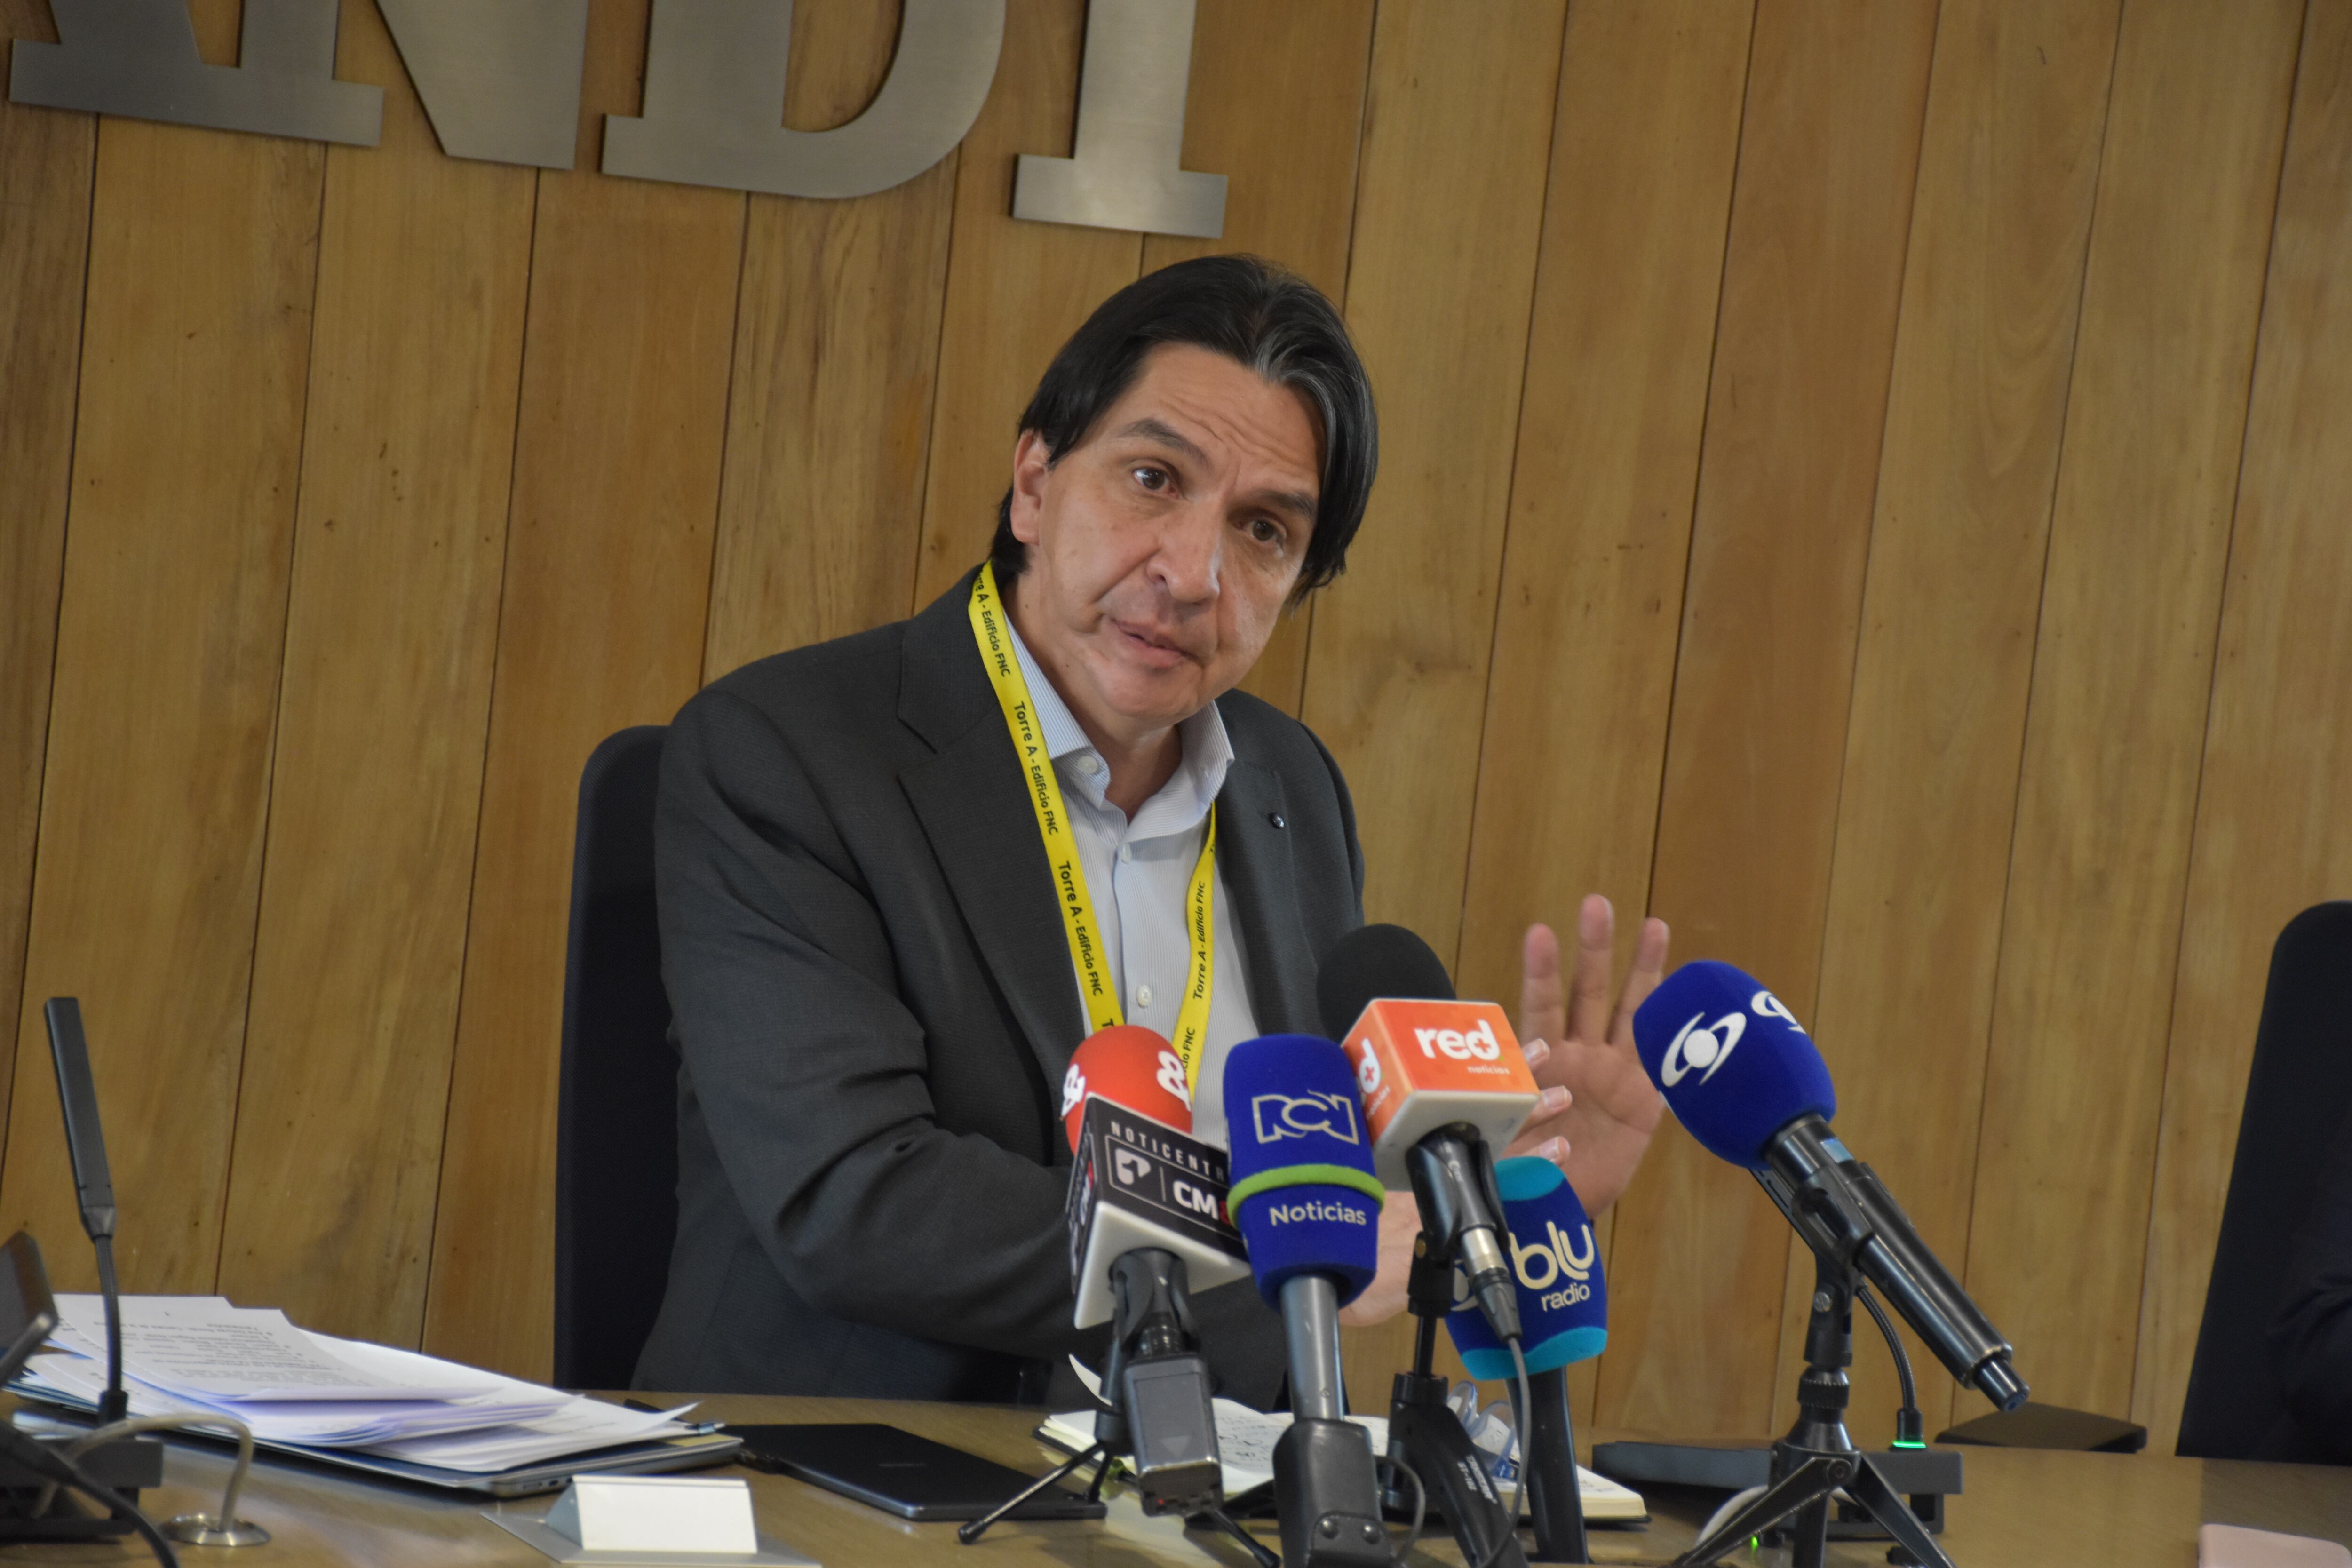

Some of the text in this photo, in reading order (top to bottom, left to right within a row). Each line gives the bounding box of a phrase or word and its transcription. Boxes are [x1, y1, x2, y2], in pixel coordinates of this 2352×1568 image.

[9, 0, 1229, 238] DI
[977, 594, 989, 603] A
[982, 610, 1000, 651] Edificio
[995, 653, 1010, 677] FNC
[1014, 701, 1032, 741] Torre
[1025, 746, 1038, 757] A
[1031, 765, 1049, 808] Edificio
[1043, 810, 1059, 835] FNC
[1058, 860, 1076, 902] Torre
[1196, 880, 1205, 905] FNC
[1070, 906, 1083, 917] A
[1195, 906, 1206, 943] Edificio
[1076, 925, 1094, 969] Edificio
[1198, 951, 1206, 962] A
[1088, 971, 1103, 996] FNC
[1193, 963, 1206, 1000] Torre
[1182, 1027, 1195, 1051] FNC
[1414, 1018, 1500, 1060] red
[1252, 1089, 1359, 1145] RCN
[1111, 1120, 1225, 1182] NOTICENTR
[1270, 1202, 1367, 1226] Noticias
[1508, 1220, 1595, 1290] blu
[1541, 1282, 1590, 1313] radio
